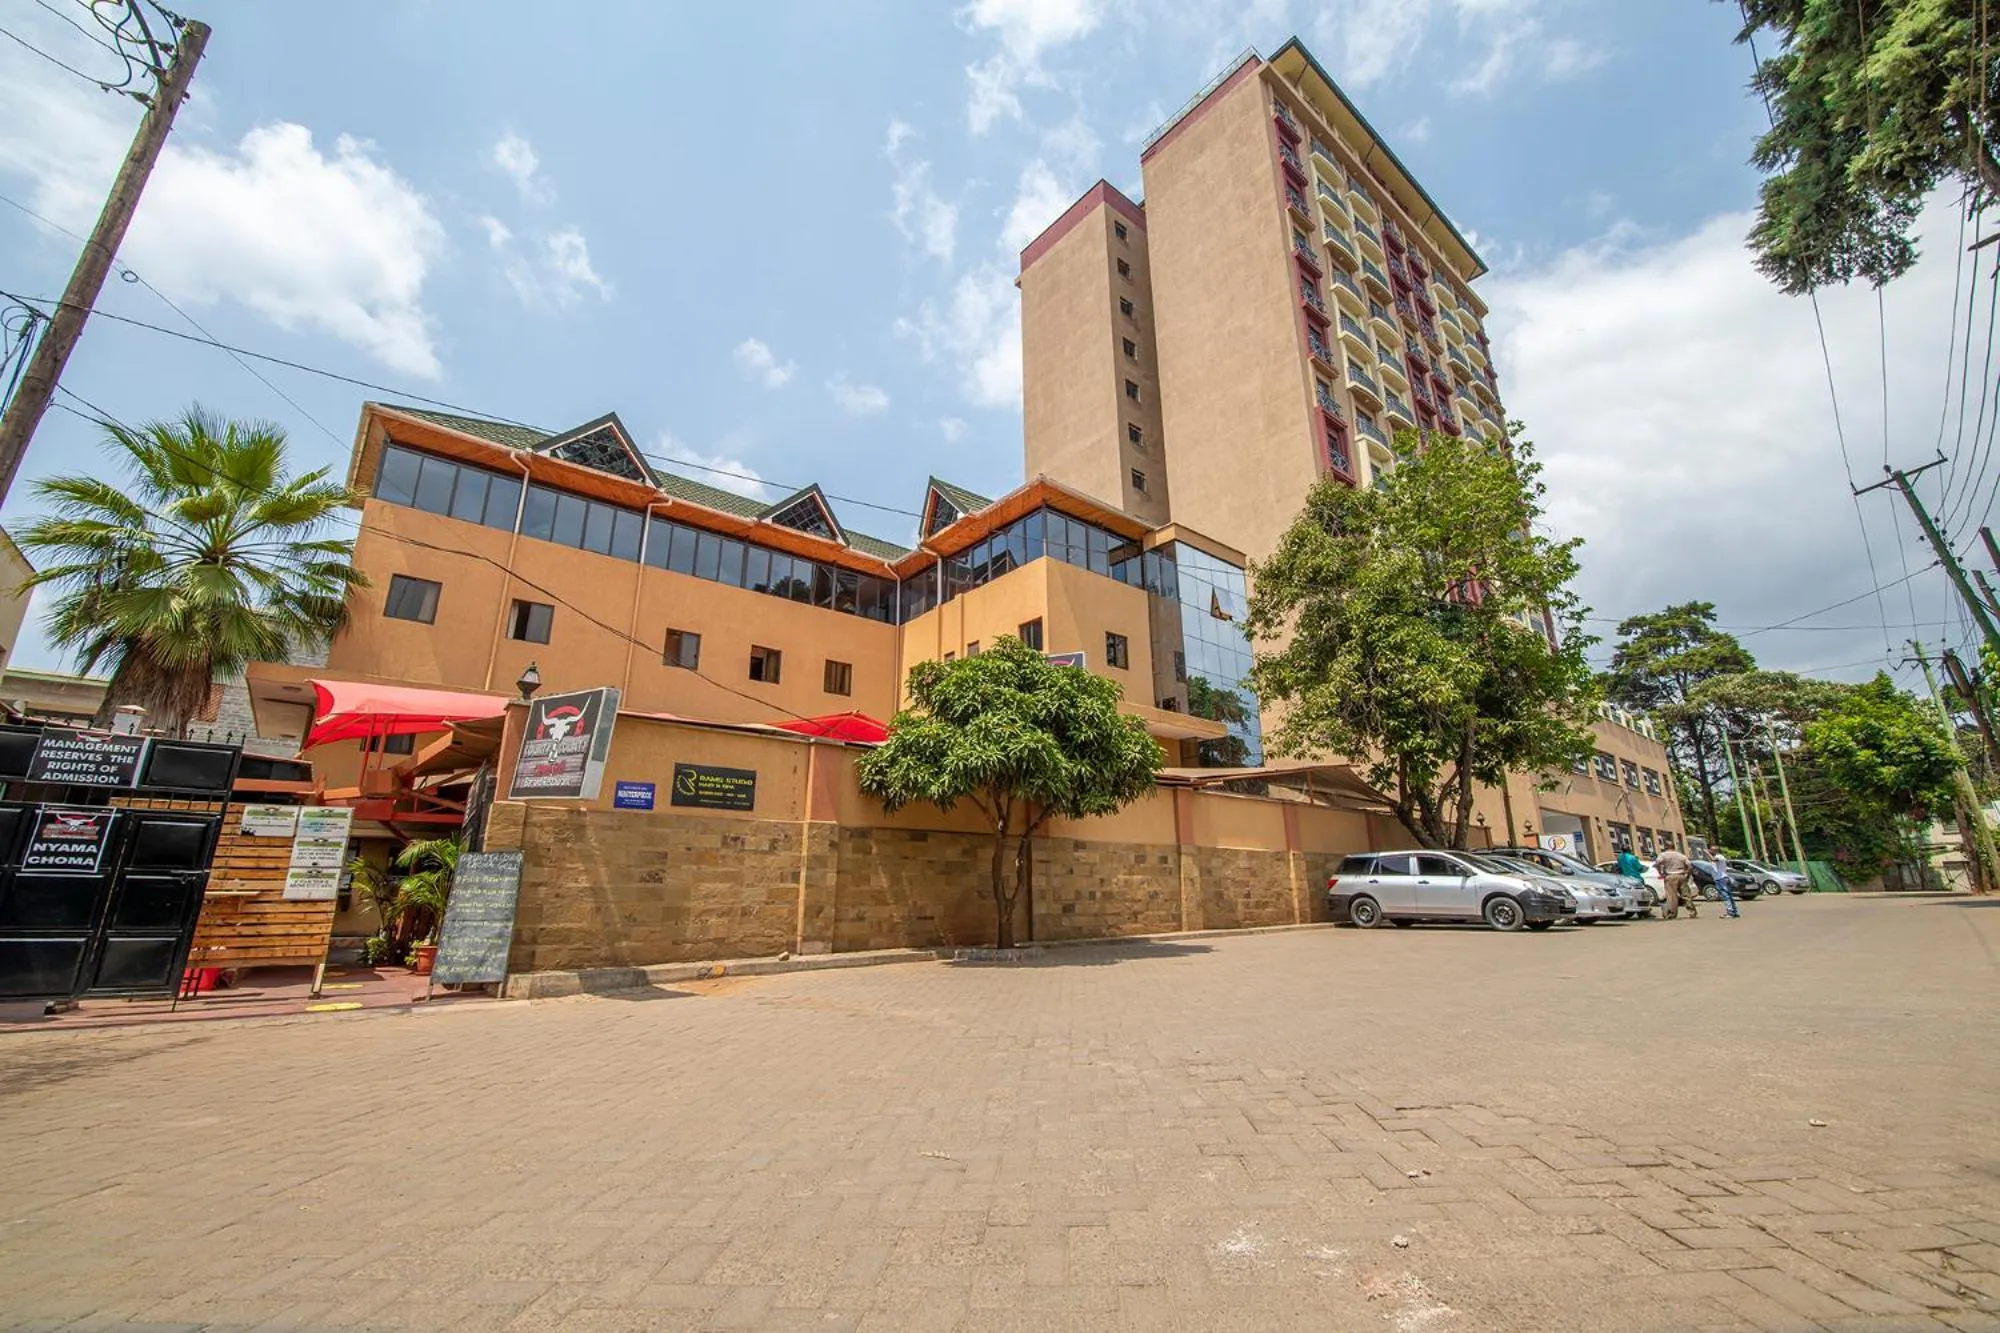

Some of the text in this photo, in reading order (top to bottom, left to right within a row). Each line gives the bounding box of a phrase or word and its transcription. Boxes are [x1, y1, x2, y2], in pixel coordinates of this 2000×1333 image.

[43, 739, 139, 754] MANAGEMENT
[40, 749, 135, 764] RESERVES THE
[47, 761, 119, 773] RIGHTS OF
[41, 771, 120, 784] ADMISSION
[33, 843, 98, 853] NYAMA
[27, 856, 95, 866] CHOMA
